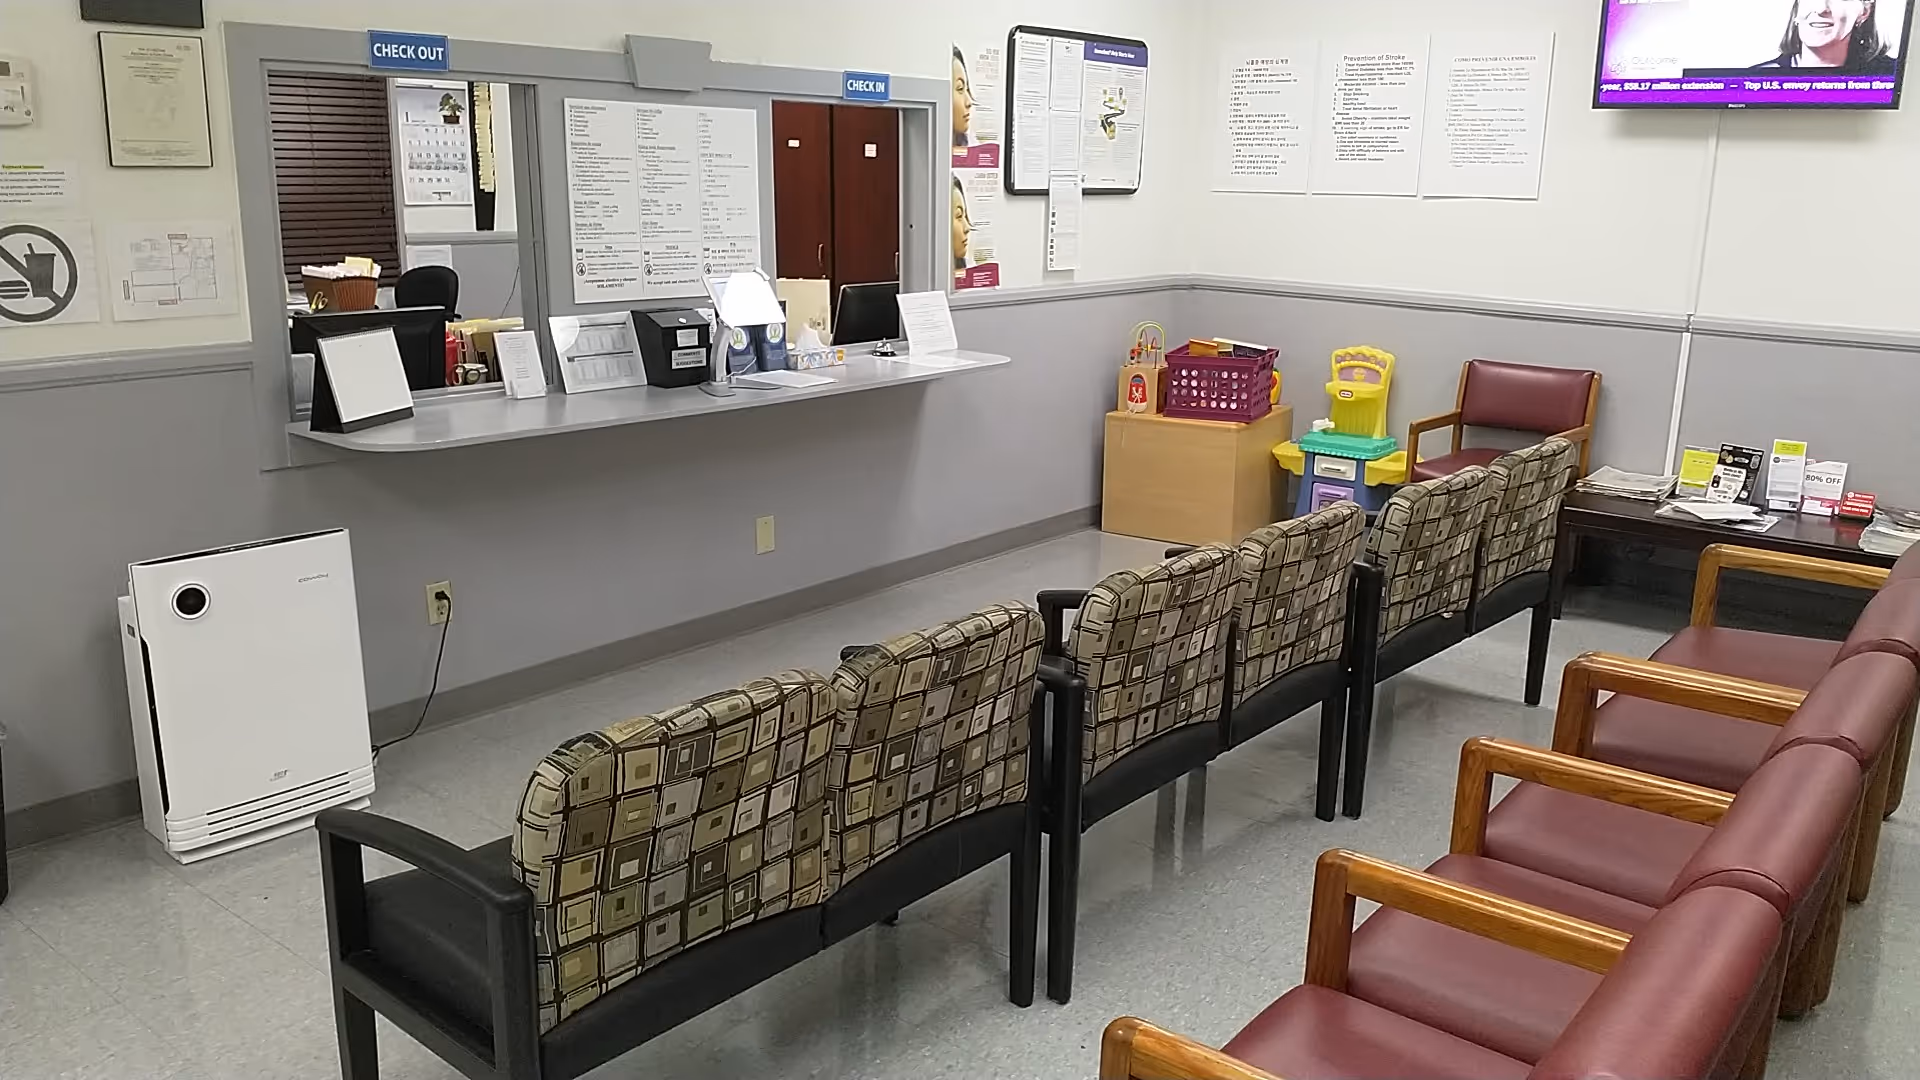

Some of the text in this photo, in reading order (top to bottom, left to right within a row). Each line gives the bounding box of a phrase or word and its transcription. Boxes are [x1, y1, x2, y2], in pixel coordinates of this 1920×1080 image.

[373, 43, 444, 61] CHECK OUT
[847, 79, 885, 93] CHECK IN
[1651, 81, 1681, 90] million
[1681, 81, 1725, 90] extension
[1744, 81, 1761, 91] Top
[1762, 81, 1781, 89] U.S.
[1782, 82, 1812, 91] envoy
[1812, 81, 1846, 89] returns
[1847, 81, 1871, 89] from
[1805, 474, 1843, 485] 80% OFF
